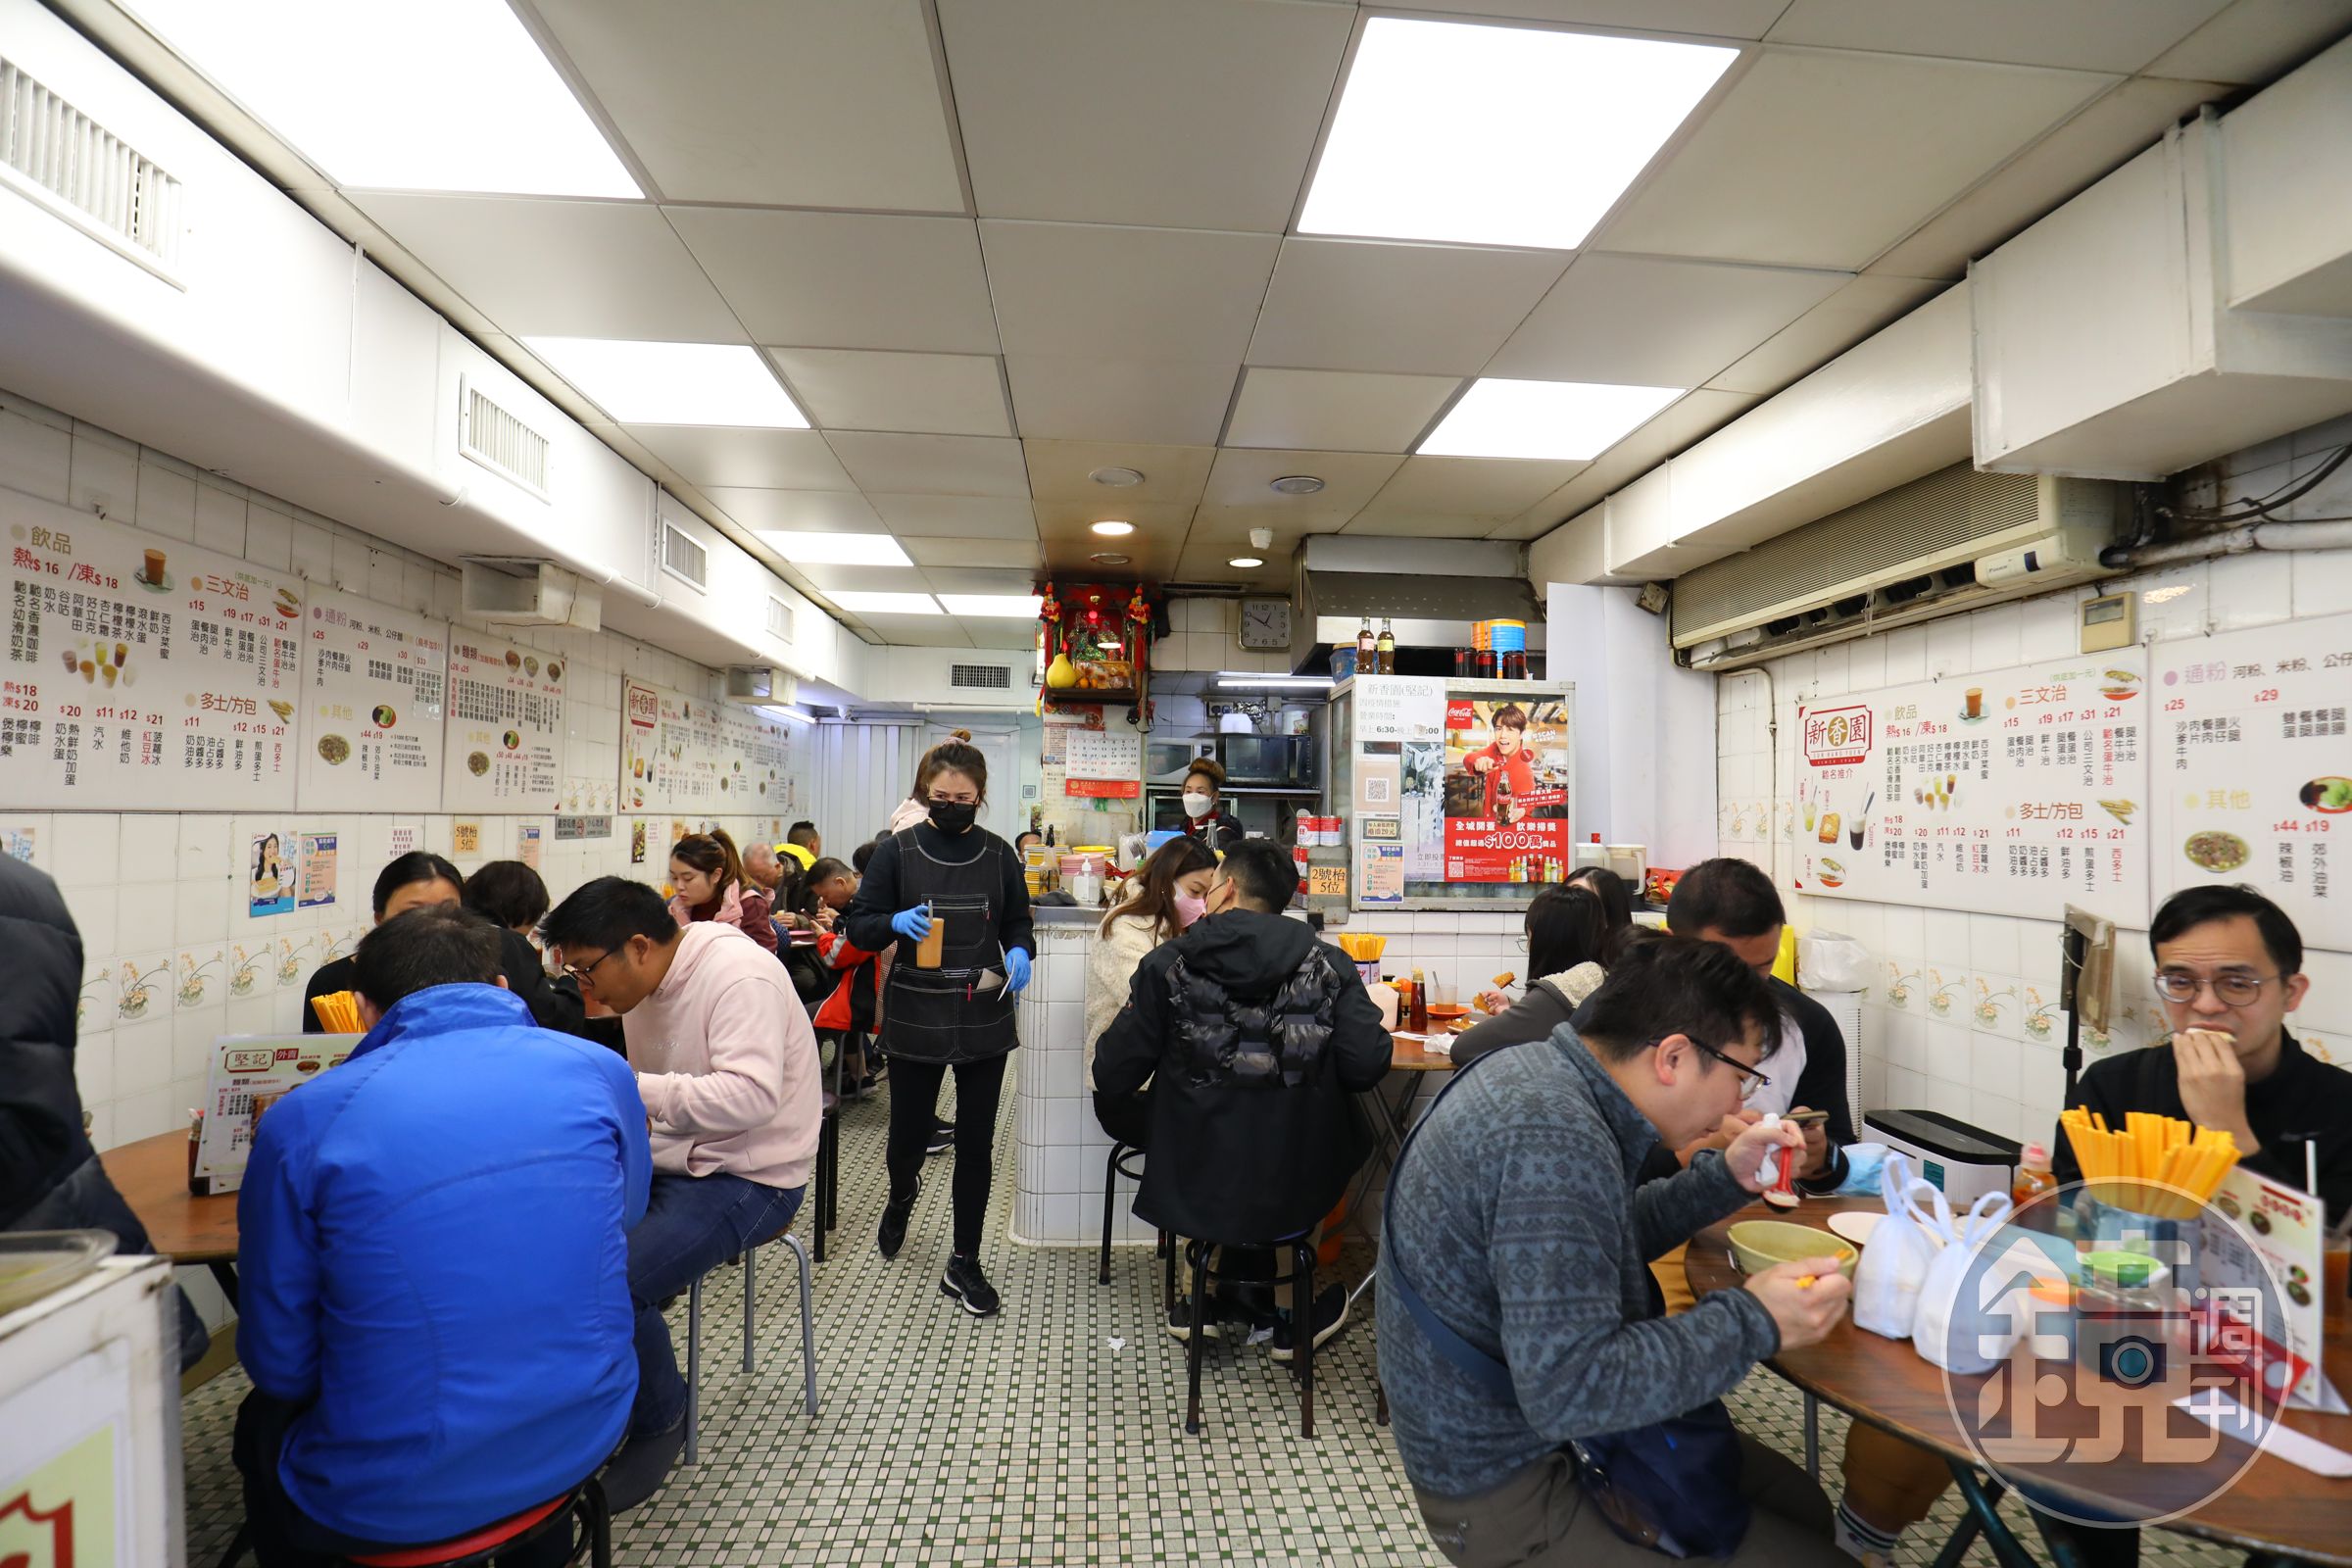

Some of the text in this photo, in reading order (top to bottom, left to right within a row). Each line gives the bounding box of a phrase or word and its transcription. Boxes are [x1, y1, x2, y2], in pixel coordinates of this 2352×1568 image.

[31, 525, 72, 556] 飲品
[206, 574, 250, 602] 三文治
[72, 593, 84, 632] 阿華田
[85, 596, 98, 635] 好立克
[2184, 661, 2227, 685] 通粉
[200, 692, 257, 715] 多士/方包
[2019, 683, 2067, 706] 三文治
[1894, 705, 1917, 721] 飲品
[92, 726, 105, 750] 汽水
[1808, 713, 1866, 748] 新香園
[2020, 802, 2083, 820] 多士/方包
[2207, 789, 2251, 810] 其他
[1320, 882, 1341, 894] 5位
